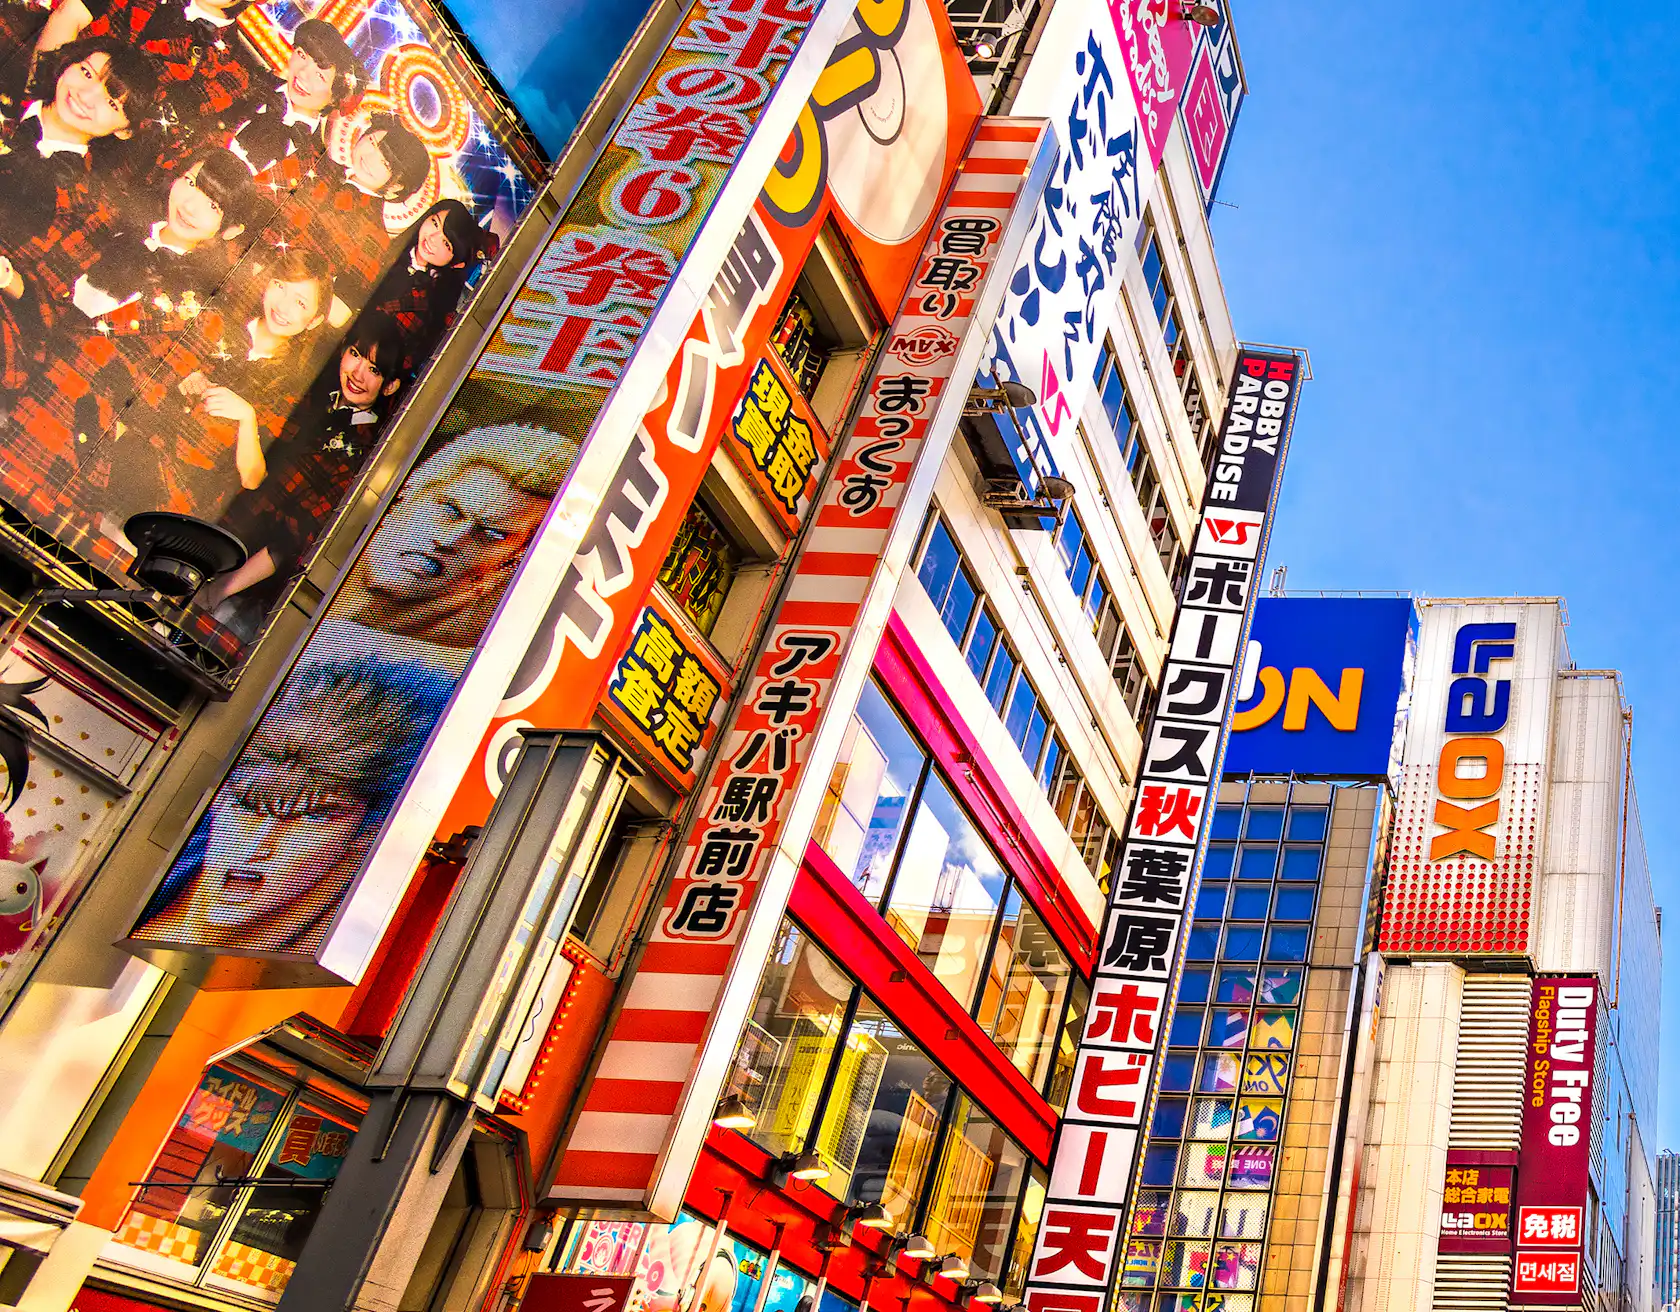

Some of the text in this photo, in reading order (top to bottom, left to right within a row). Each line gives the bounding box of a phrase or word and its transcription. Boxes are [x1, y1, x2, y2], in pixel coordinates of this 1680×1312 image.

[842, 374, 934, 516] まっくす
[1210, 357, 1264, 501] PARADISE
[1251, 360, 1297, 458] HOBBY
[669, 631, 834, 934] アキバ駅前店
[1532, 986, 1554, 1108] Flagship Store
[1548, 986, 1594, 1147] Duty Free
[1443, 1187, 1510, 1204] 総合家電
[1446, 1169, 1480, 1186] 本店
[1524, 1213, 1576, 1239] 免税
[1520, 1262, 1575, 1282] 면세점
